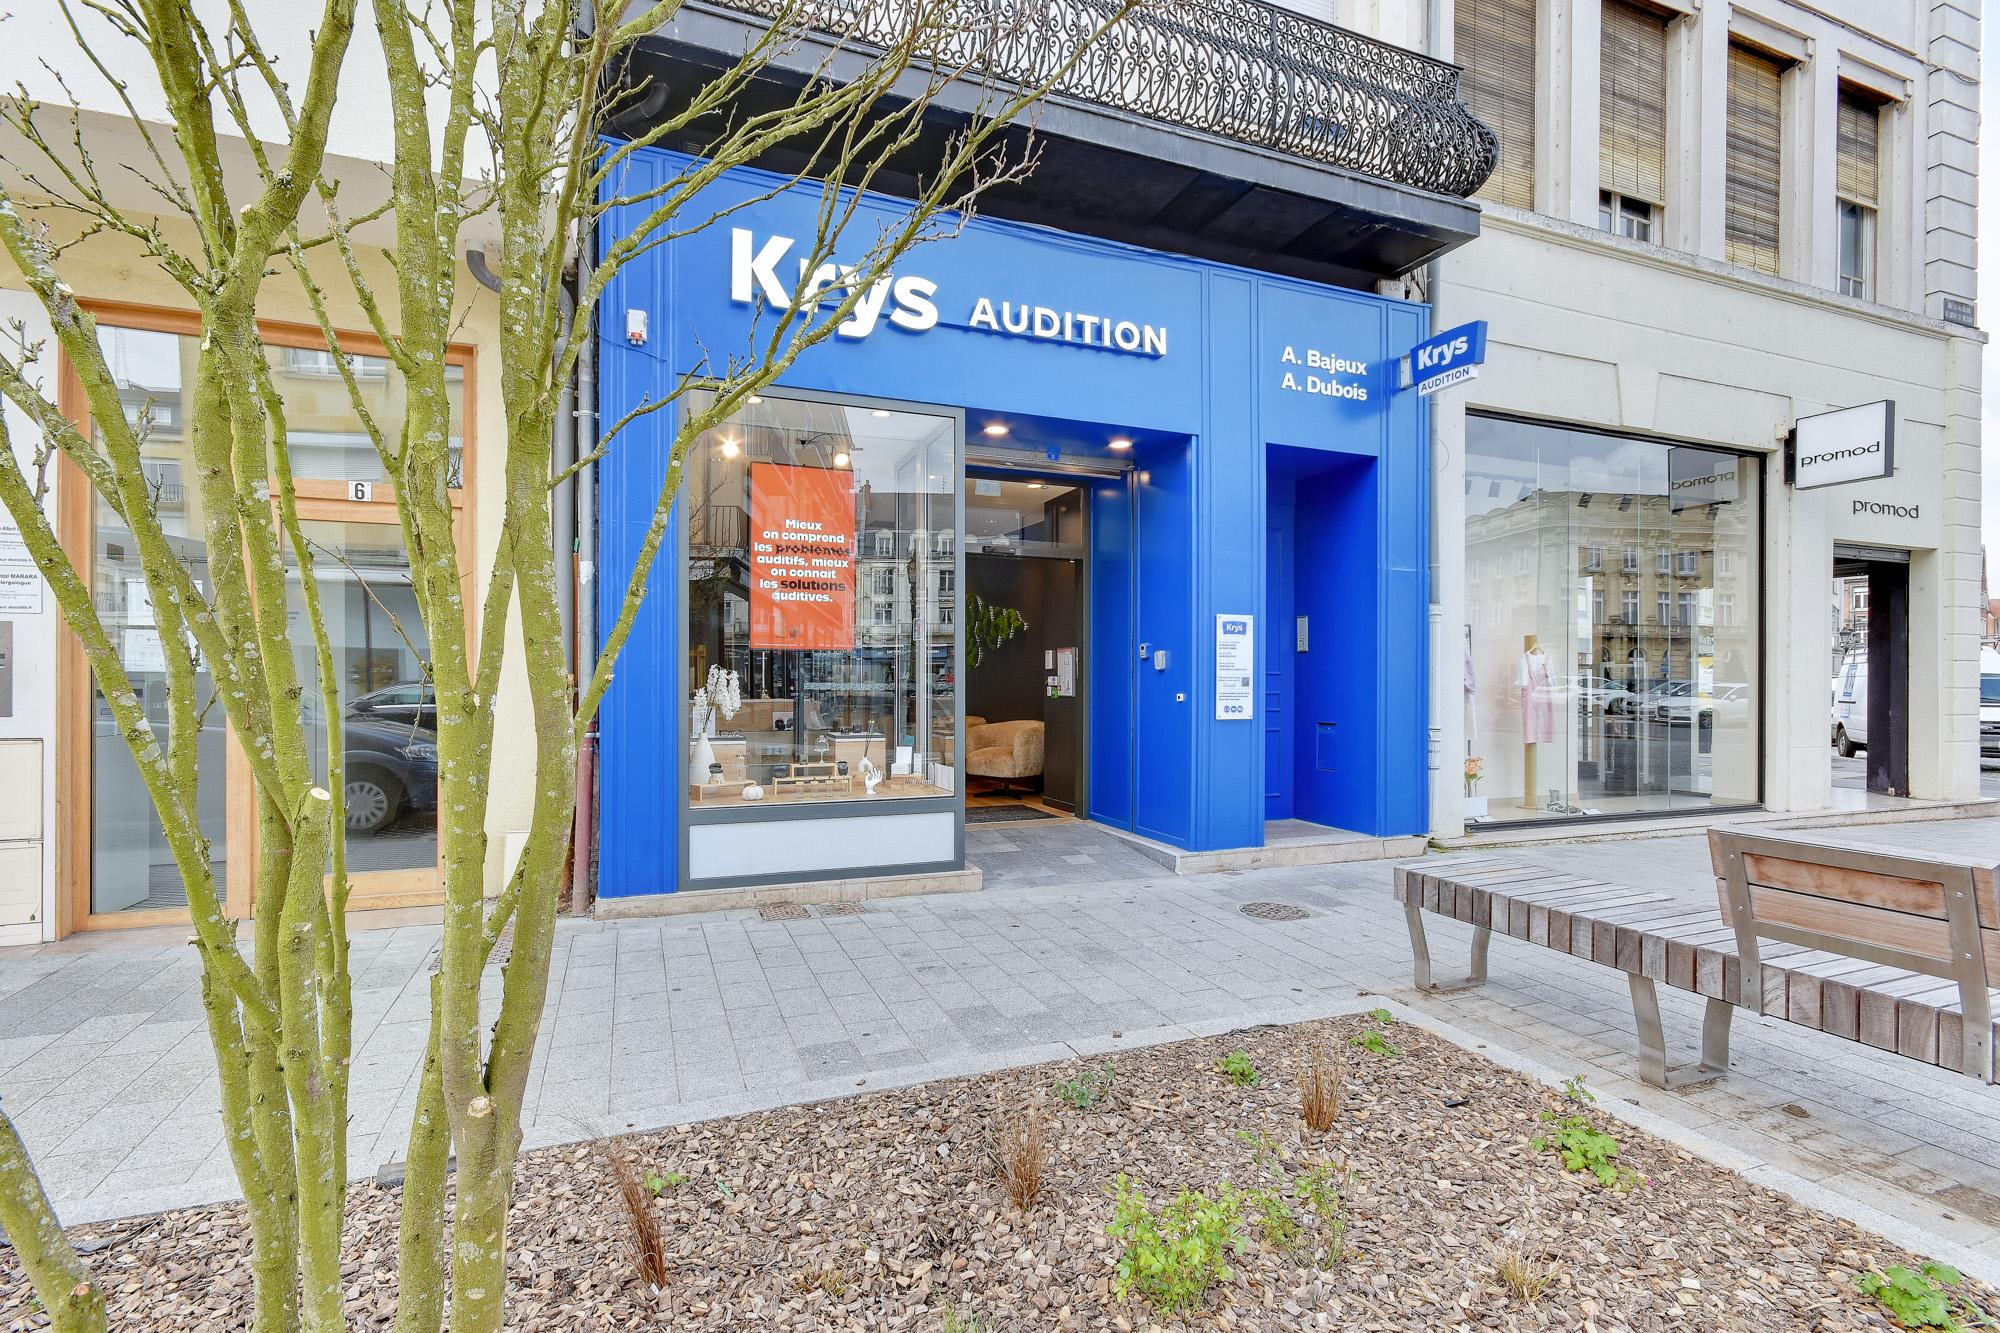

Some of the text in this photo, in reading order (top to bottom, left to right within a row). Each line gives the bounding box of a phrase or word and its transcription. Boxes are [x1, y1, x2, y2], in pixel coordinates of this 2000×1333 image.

[731, 228, 1167, 355] Krys AUDITION
[1281, 346, 1367, 376] A. Bajeux
[1418, 336, 1468, 371] Krys
[1281, 372, 1368, 401] A. Dubois
[1420, 366, 1470, 393] AUDITION
[1801, 441, 1880, 468] promod
[354, 482, 365, 500] 6
[1852, 500, 1919, 519] promod
[785, 519, 823, 530] Mieux
[762, 530, 845, 543] on comprend
[754, 542, 773, 552] les
[756, 555, 849, 568] auditifs, mieux
[770, 567, 787, 576] on
[759, 579, 846, 592] les solutions
[772, 591, 833, 602] auditives.
[1226, 623, 1244, 633] Krys
